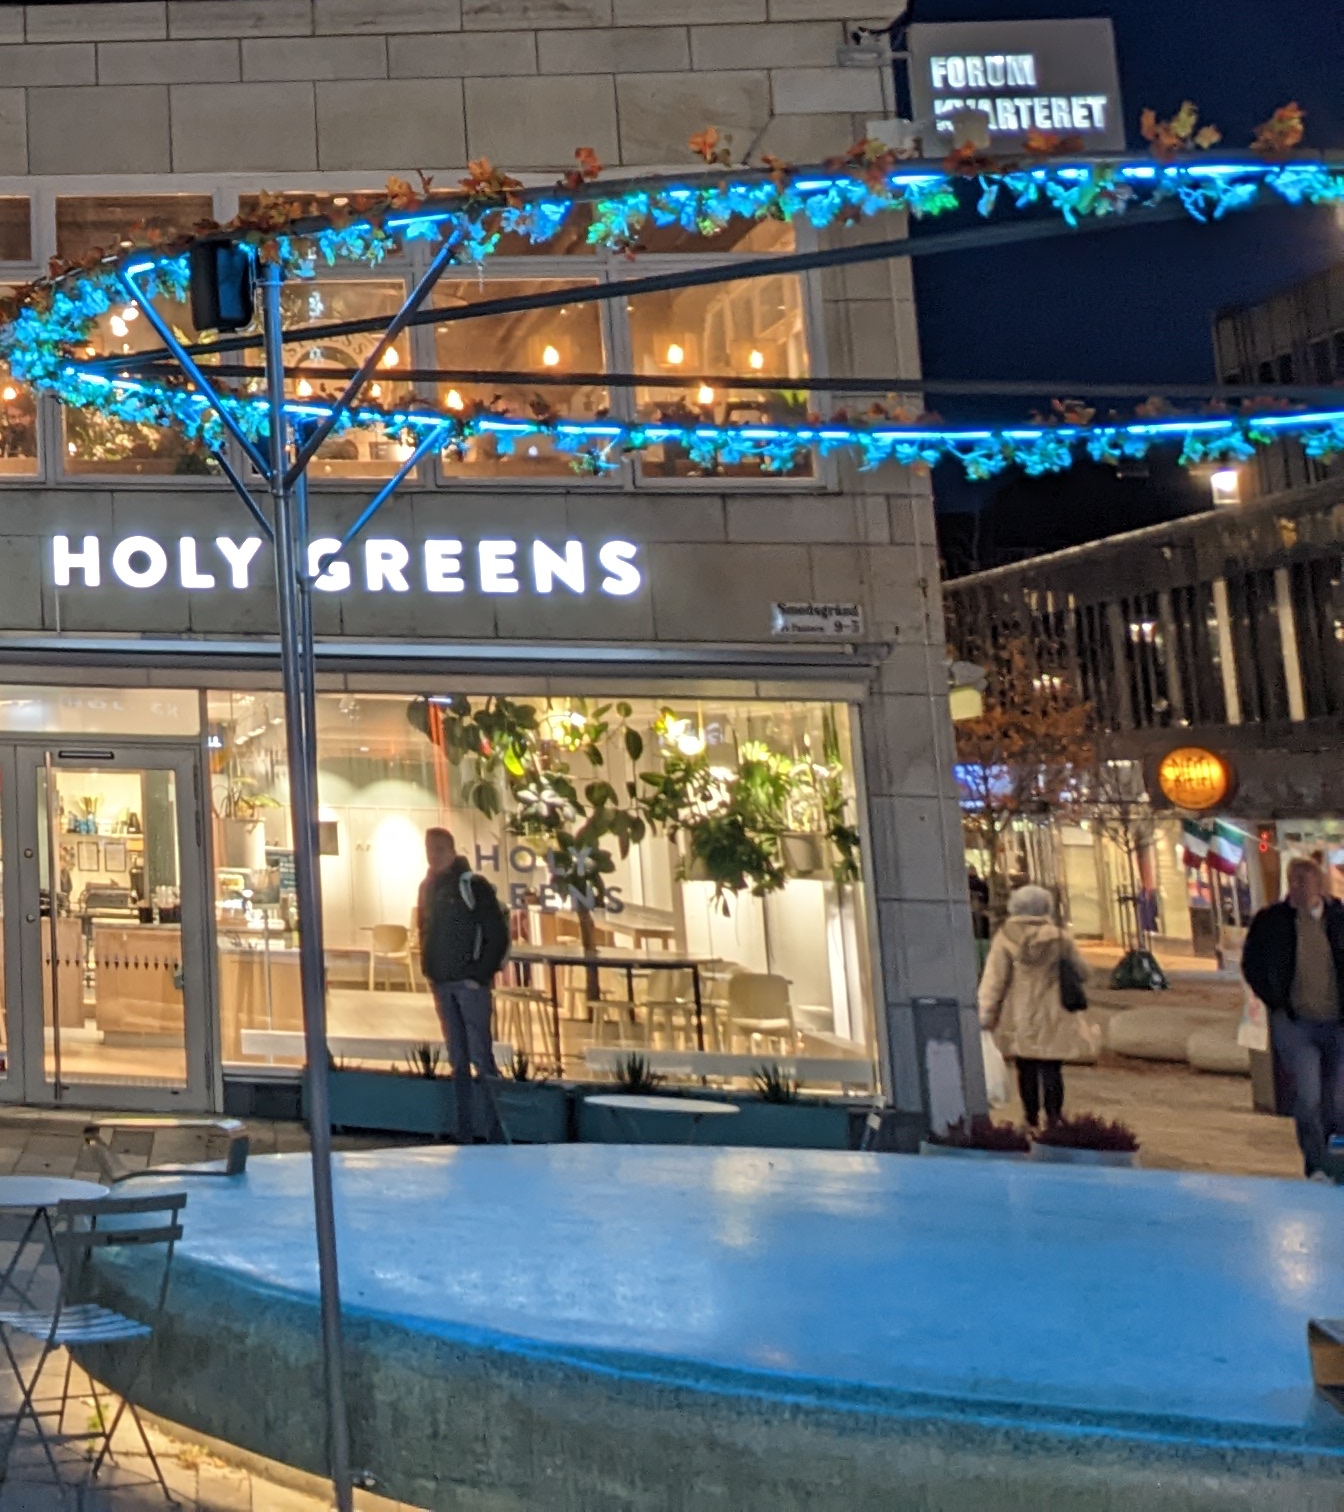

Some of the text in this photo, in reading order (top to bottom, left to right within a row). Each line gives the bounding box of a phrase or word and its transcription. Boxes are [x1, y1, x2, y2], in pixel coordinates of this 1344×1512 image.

[930, 55, 1036, 88] FORUM
[52, 535, 642, 596] HOLY GREENS
[475, 844, 592, 877] HOLY
[509, 882, 624, 914] EENS
